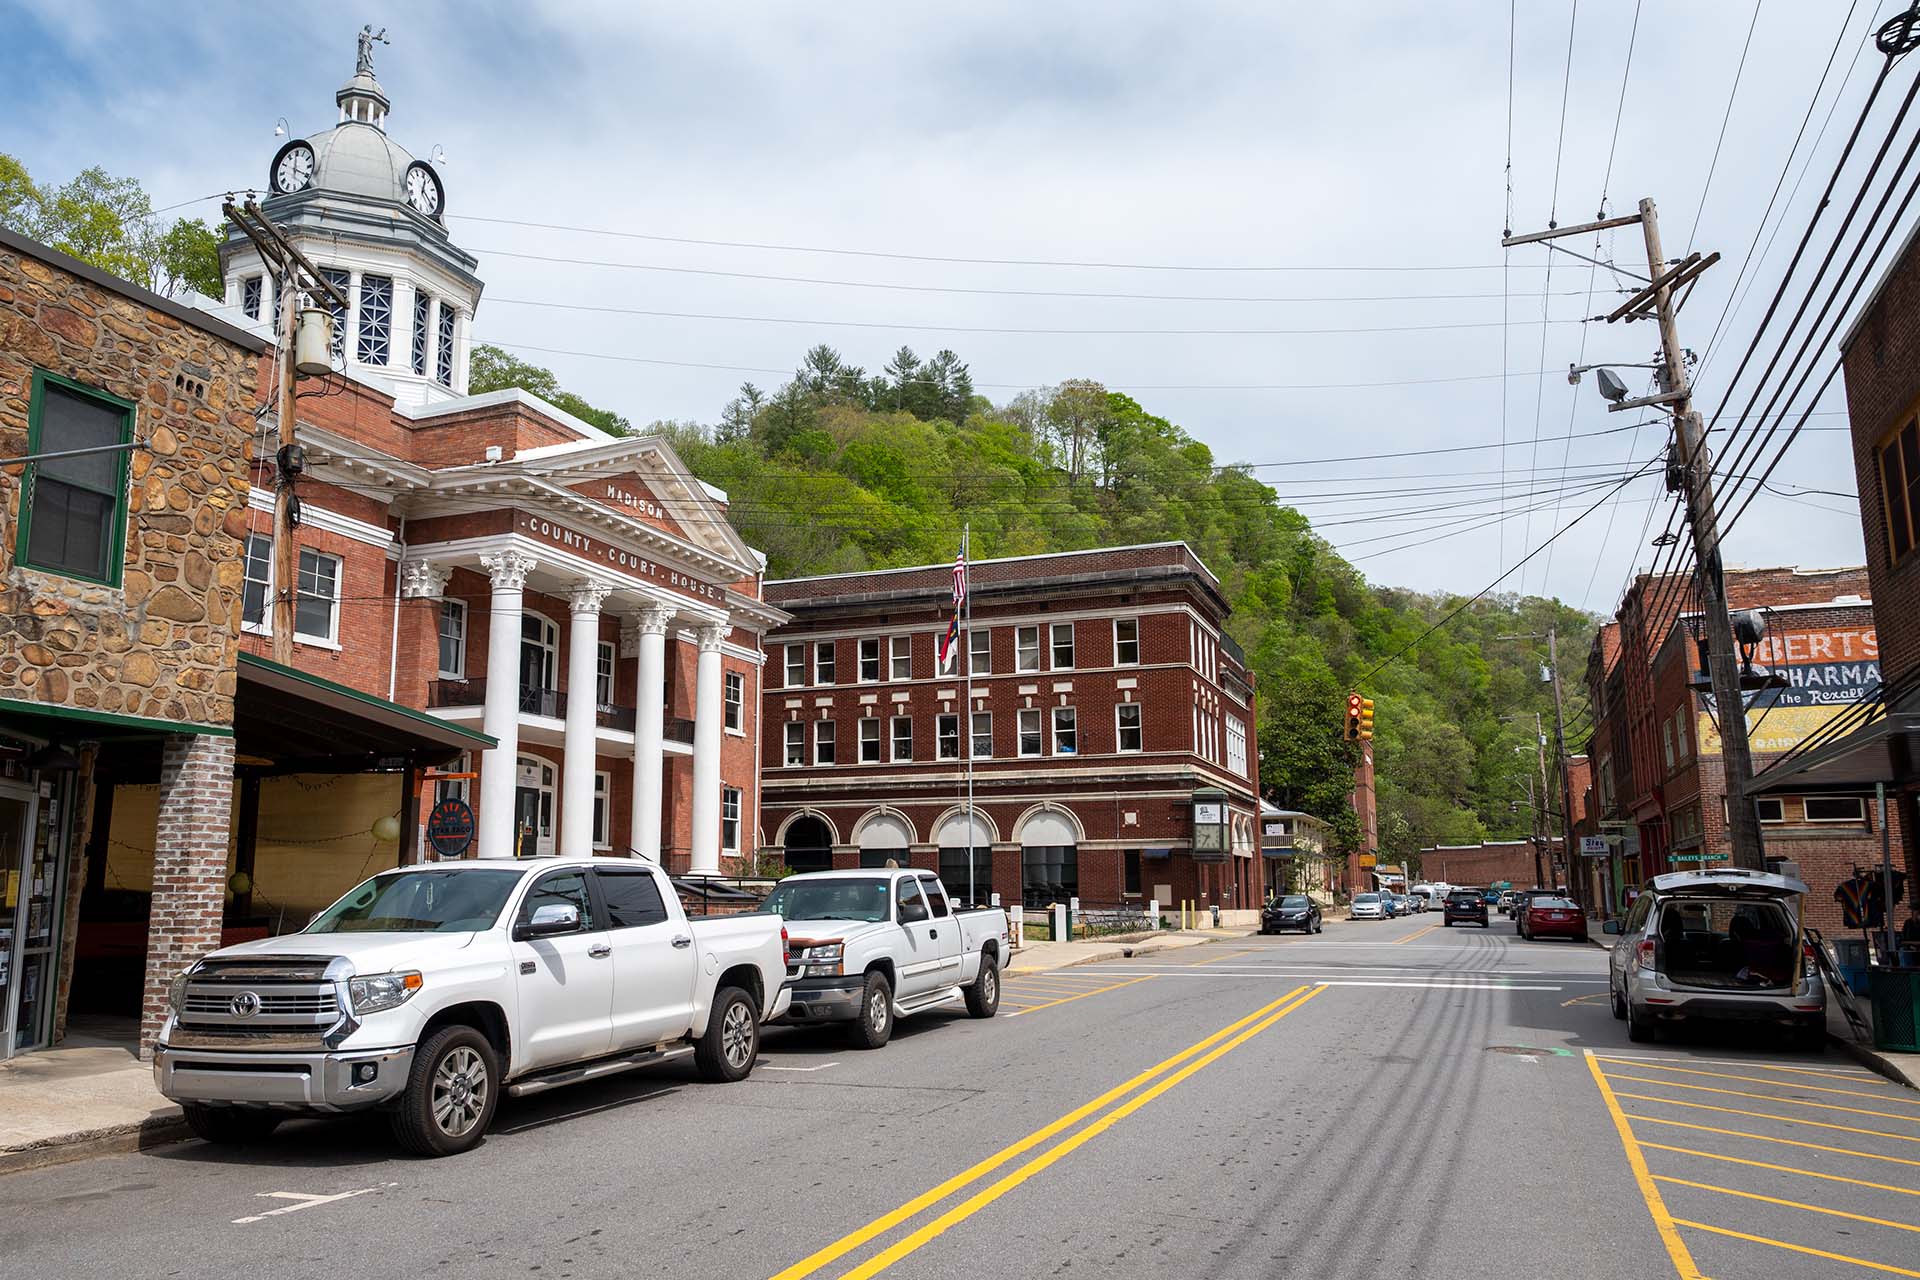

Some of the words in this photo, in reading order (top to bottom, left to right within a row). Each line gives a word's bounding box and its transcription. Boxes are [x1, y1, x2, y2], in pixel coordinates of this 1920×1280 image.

[607, 484, 663, 520] MADISON
[530, 518, 590, 552] COUNTY
[608, 548, 656, 577] COURT
[671, 572, 714, 599] HOUSE
[1734, 630, 1879, 663] OBERTS
[1780, 694, 1801, 704] The
[1808, 687, 1865, 704] Rexall
